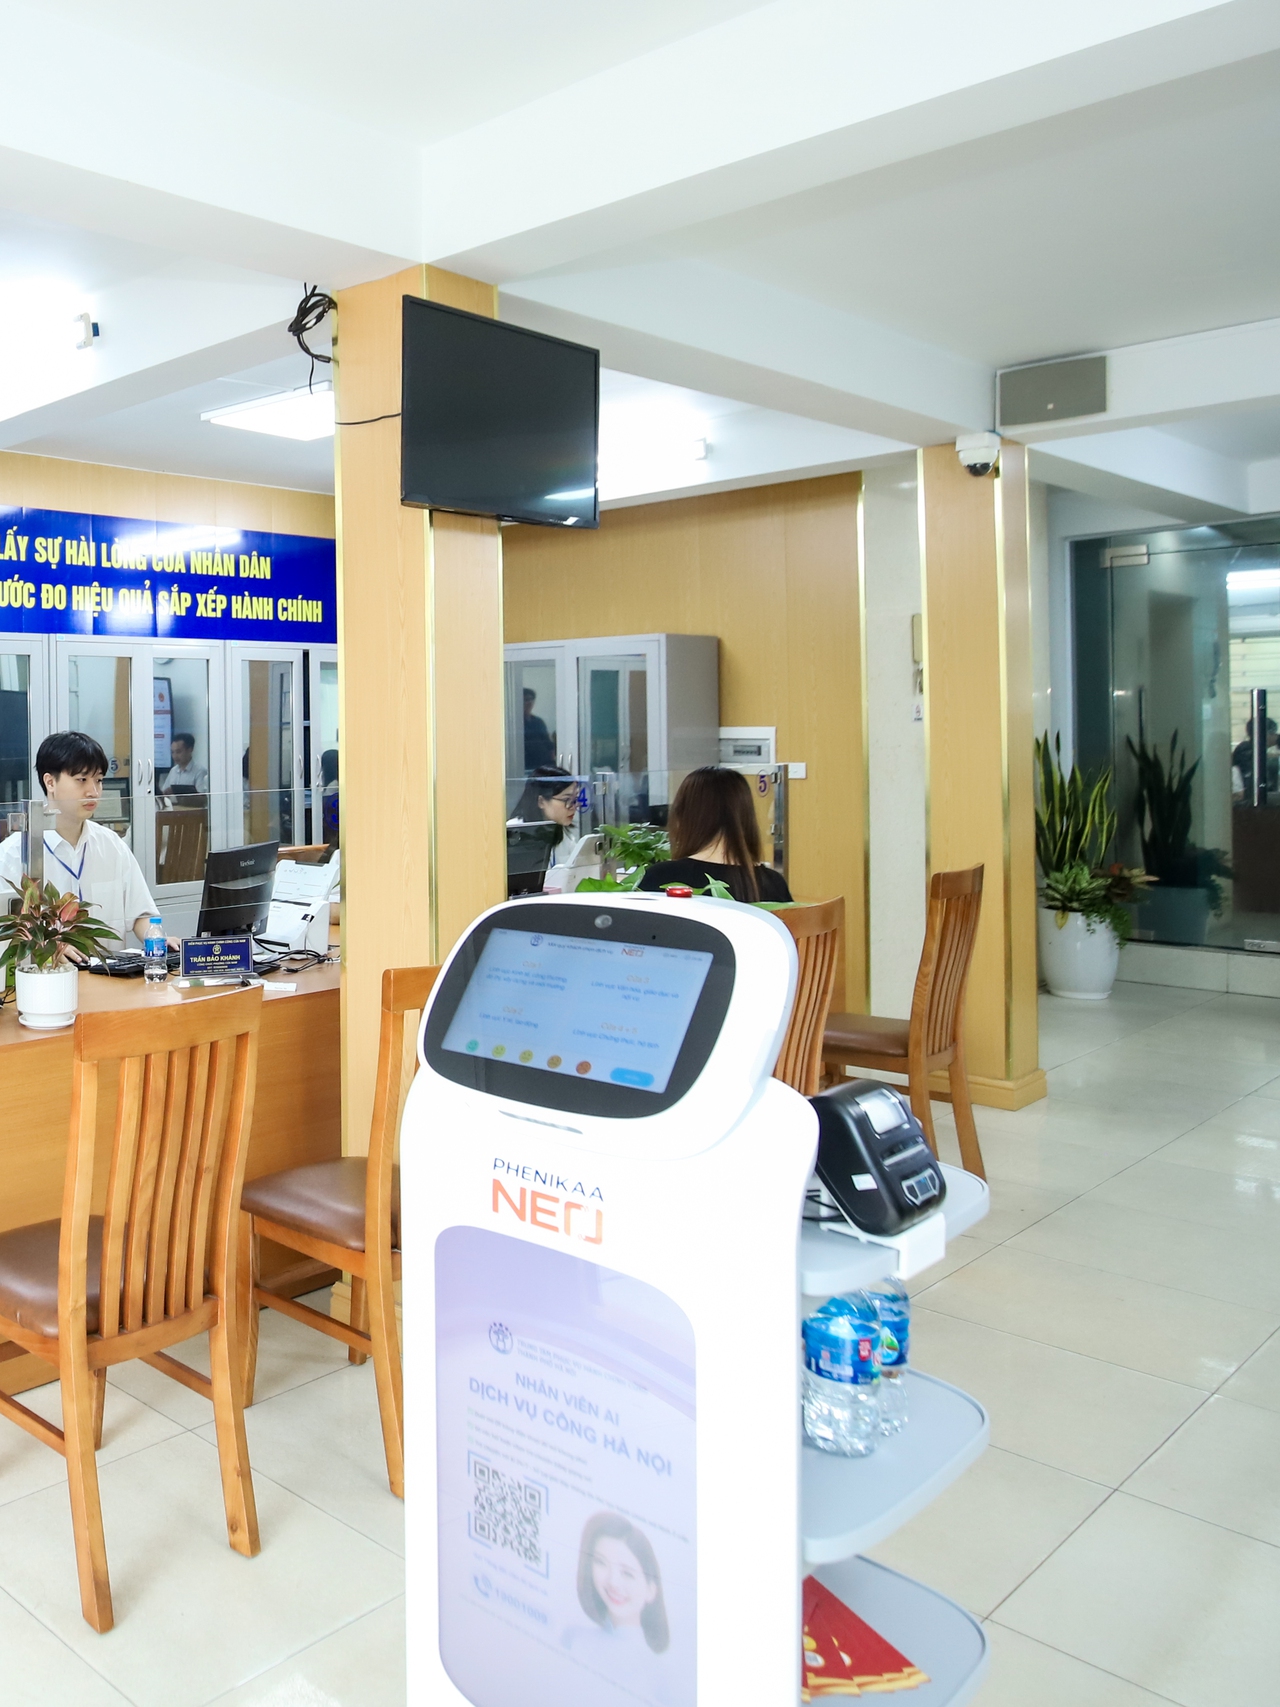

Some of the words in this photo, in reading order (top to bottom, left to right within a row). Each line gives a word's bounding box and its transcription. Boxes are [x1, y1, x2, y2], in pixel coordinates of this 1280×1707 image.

[34, 536, 62, 569] SỰ
[65, 536, 96, 566] HÀI
[190, 546, 235, 576] NHÂN
[239, 551, 271, 579] DÂN
[40, 584, 66, 610] ĐO
[72, 581, 113, 617] HIỆU
[119, 580, 153, 615] QUẢ
[158, 584, 191, 616] SẮP
[196, 586, 227, 617] XẾP
[231, 591, 273, 620] HÀNH
[277, 595, 322, 622] CHÍNH
[577, 787, 588, 808] 4
[759, 774, 767, 793] 5
[493, 1157, 604, 1203] PHENIKAA
[515, 1372, 559, 1403] NHÂN
[563, 1391, 599, 1419] VIÊN
[604, 1408, 620, 1427] AI
[469, 1377, 509, 1407] DỊCH
[513, 1395, 537, 1421] VỤ
[543, 1407, 597, 1445] CÔNG
[603, 1433, 630, 1460] HÀ
[636, 1446, 672, 1477] NỘI
